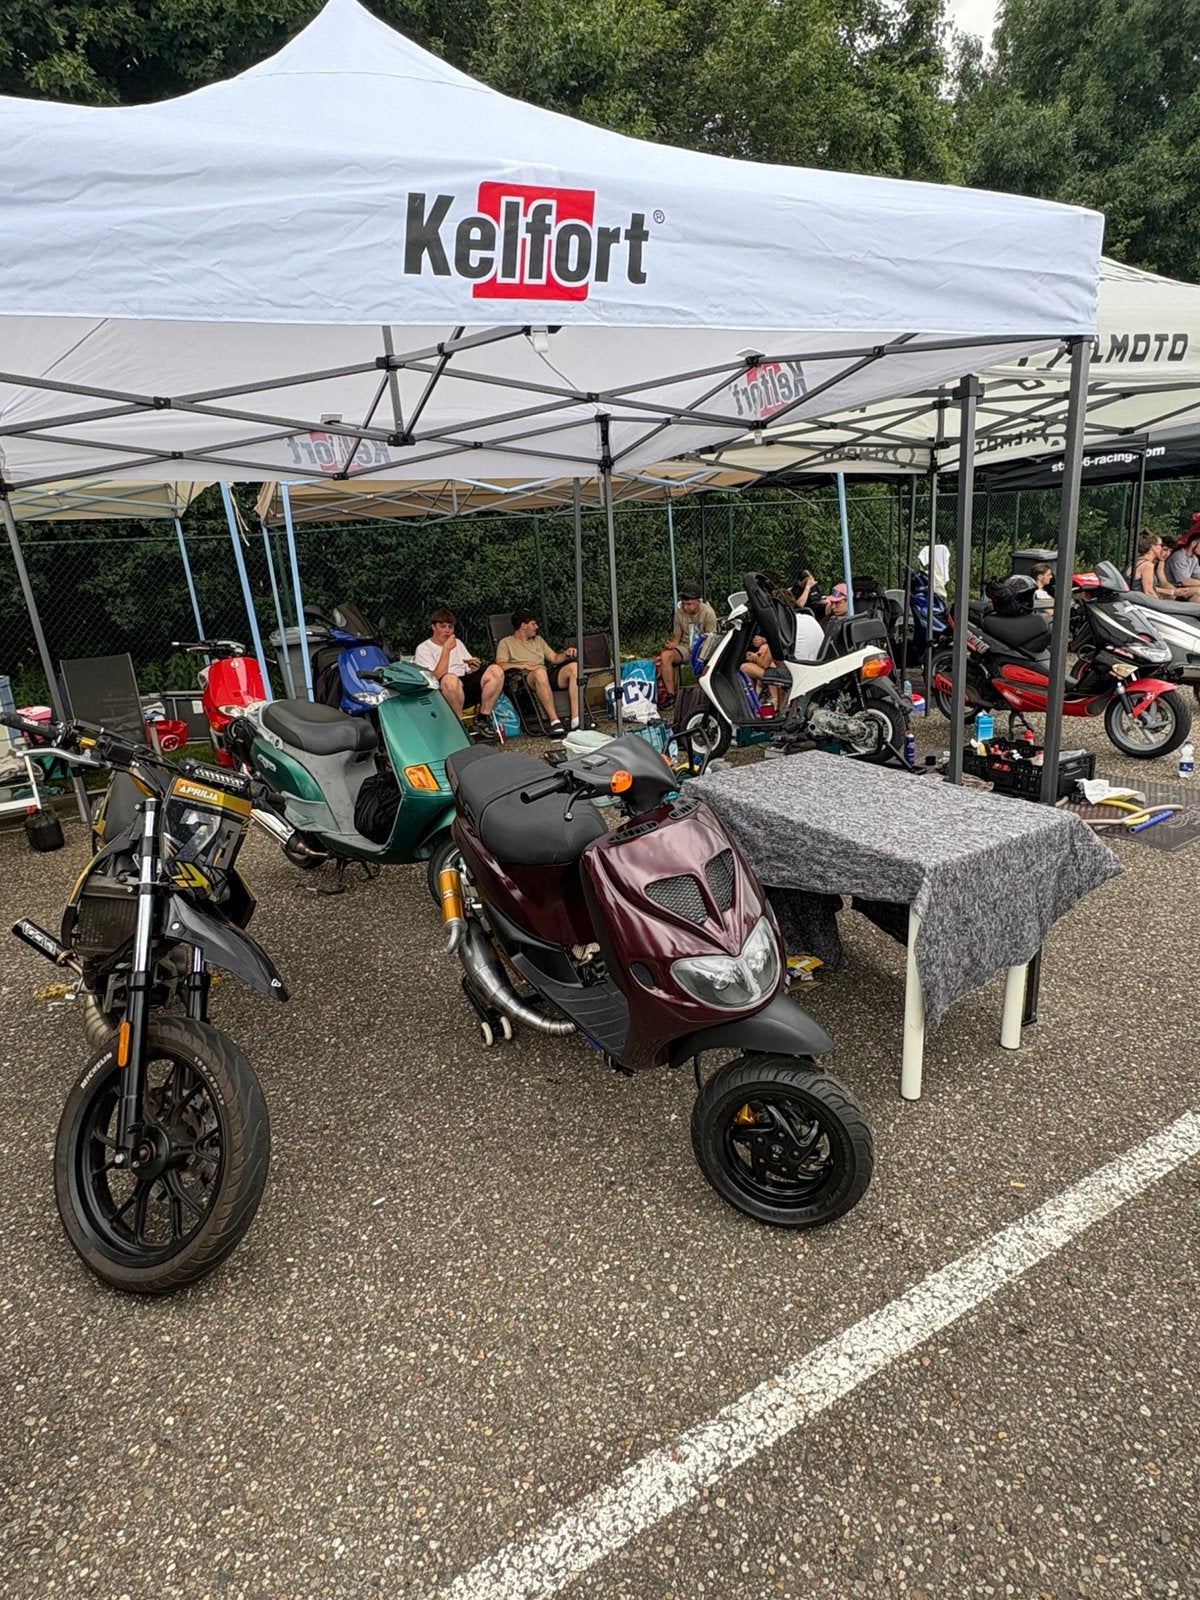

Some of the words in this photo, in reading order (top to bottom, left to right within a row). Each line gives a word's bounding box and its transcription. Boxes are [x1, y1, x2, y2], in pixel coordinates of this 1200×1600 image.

[403, 192, 650, 285] Kelfort
[1066, 333, 1189, 363] LMOTO
[1051, 446, 1166, 472] st6-racing.om
[178, 784, 218, 801] APRILIA
[80, 1051, 113, 1089] MICHELIN
